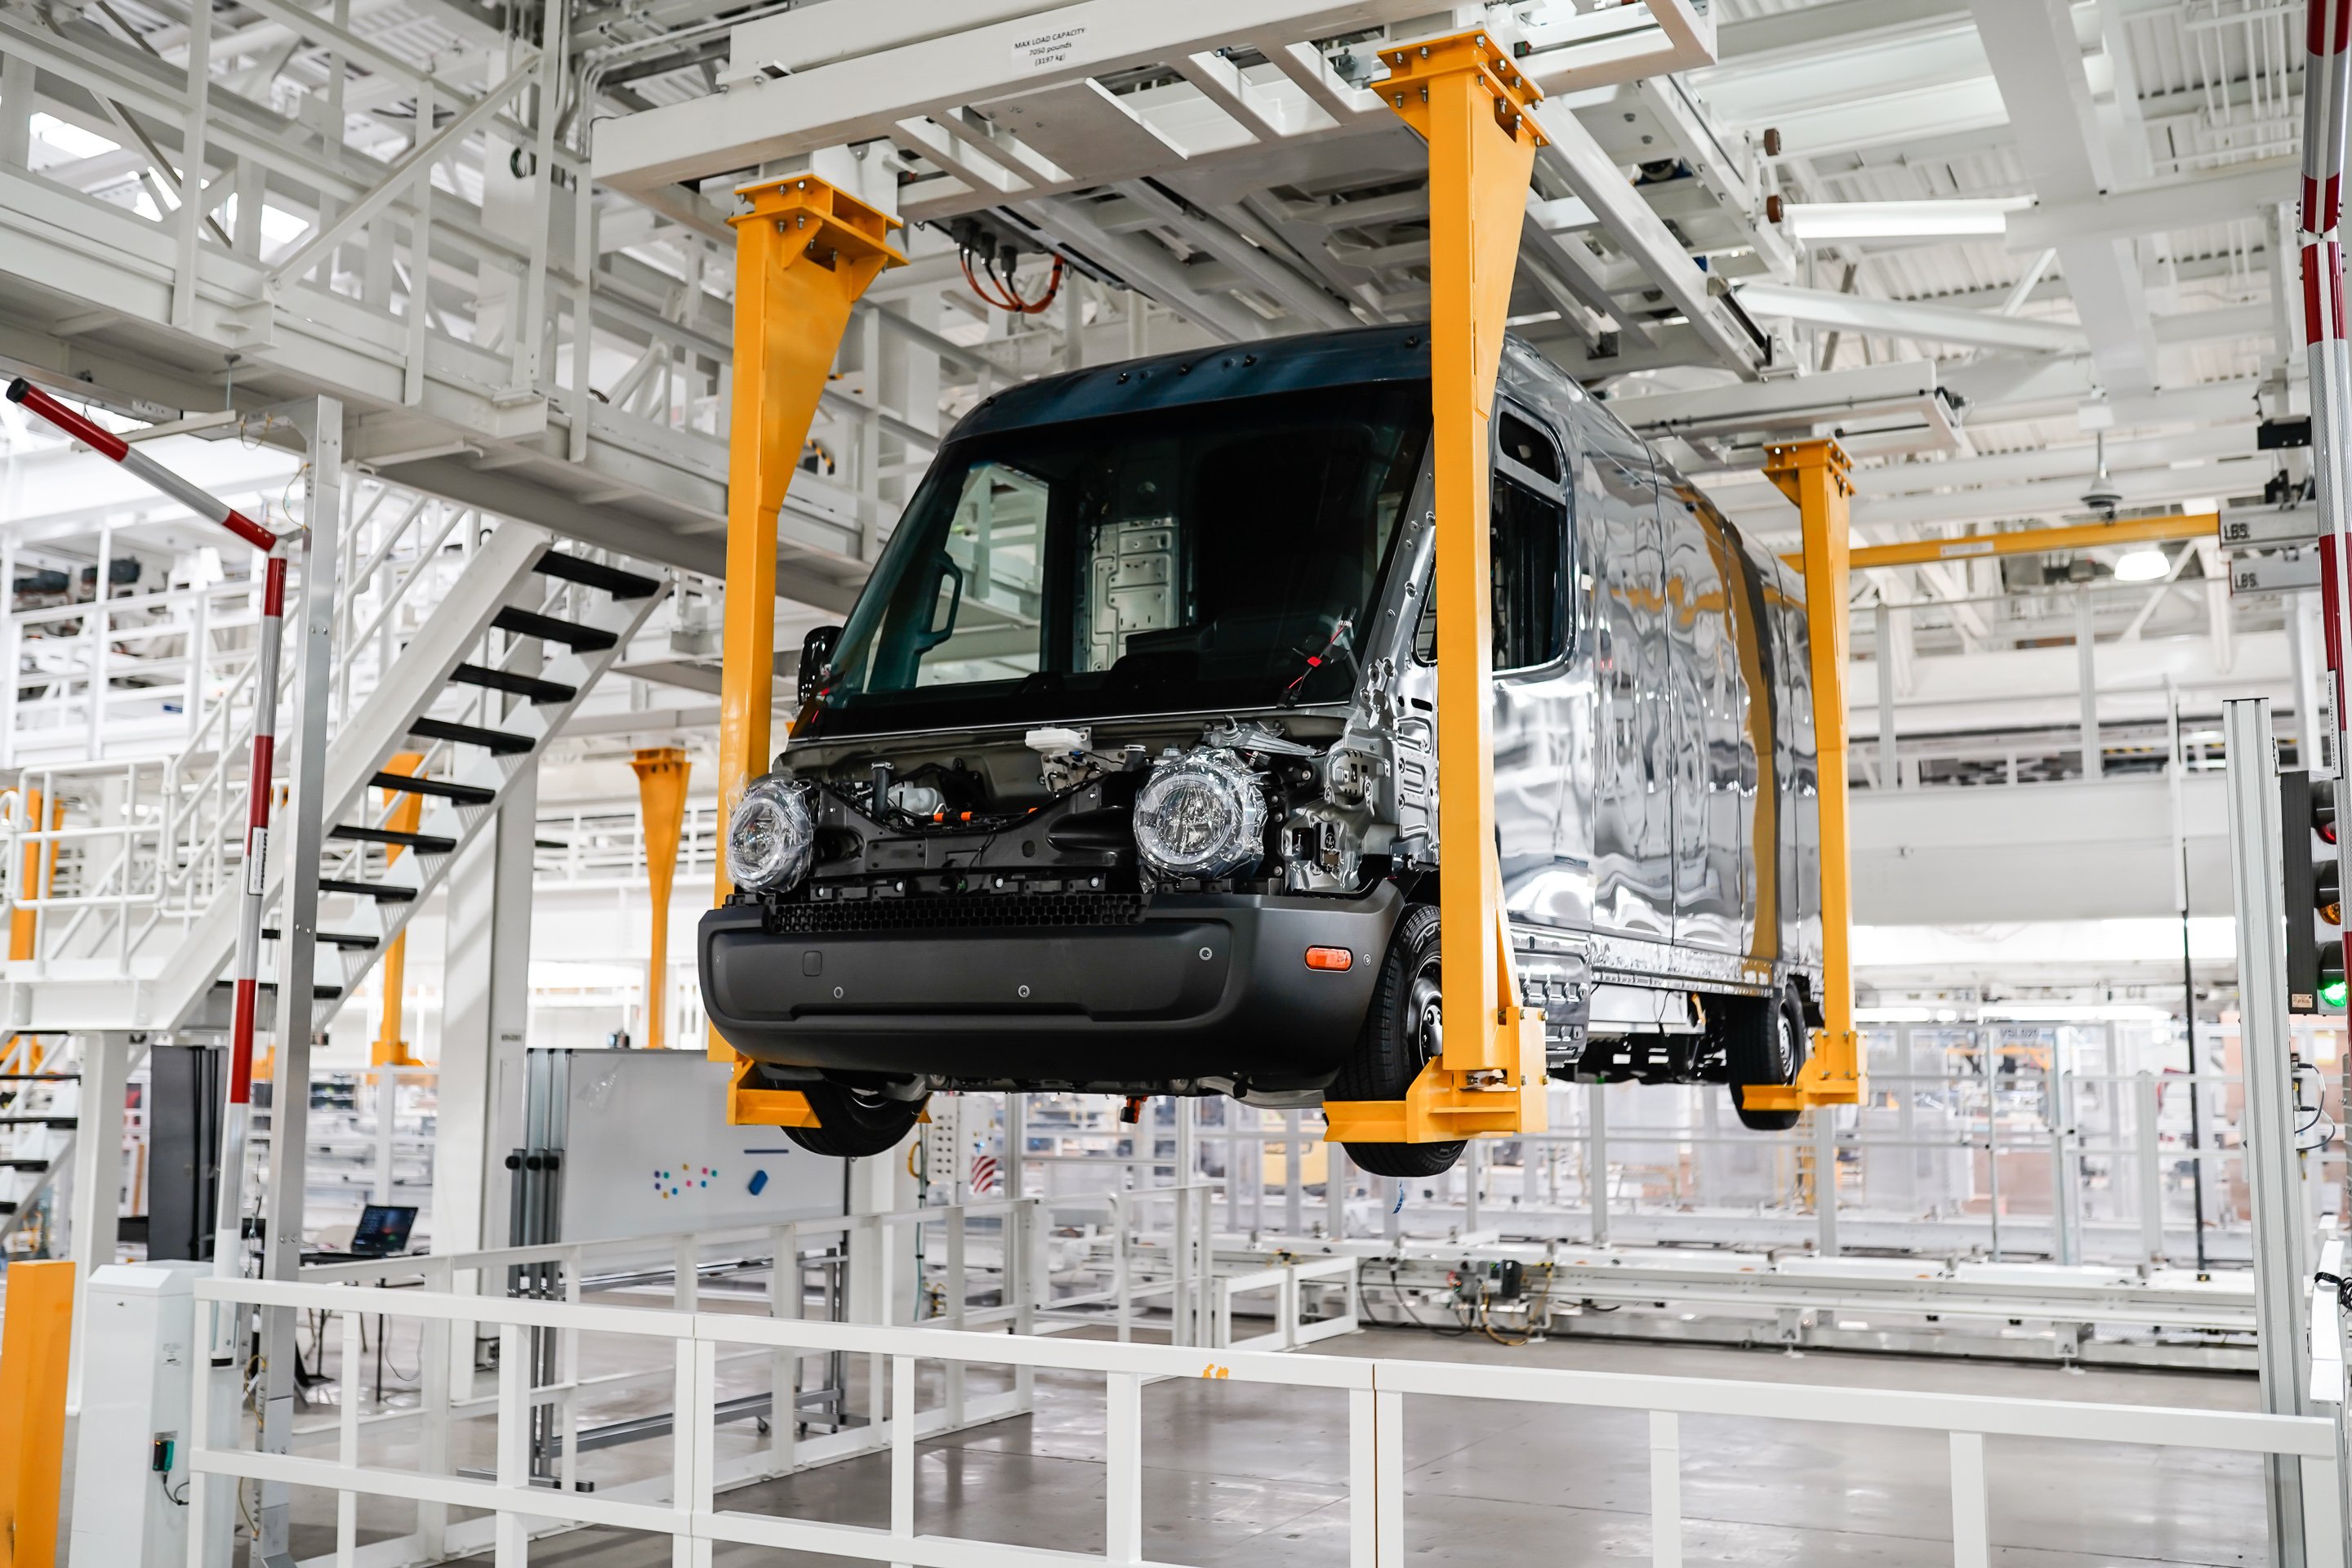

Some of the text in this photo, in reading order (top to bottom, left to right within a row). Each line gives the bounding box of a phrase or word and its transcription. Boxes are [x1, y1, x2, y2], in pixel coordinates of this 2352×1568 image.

[1014, 28, 1085, 48] MAX LOAD CAPACITY
[1029, 42, 1071, 56] 7050 pounds
[1035, 53, 1066, 66] (3197 kg)
[2224, 523, 2251, 540] LBS.
[2234, 572, 2259, 588] LBS.
